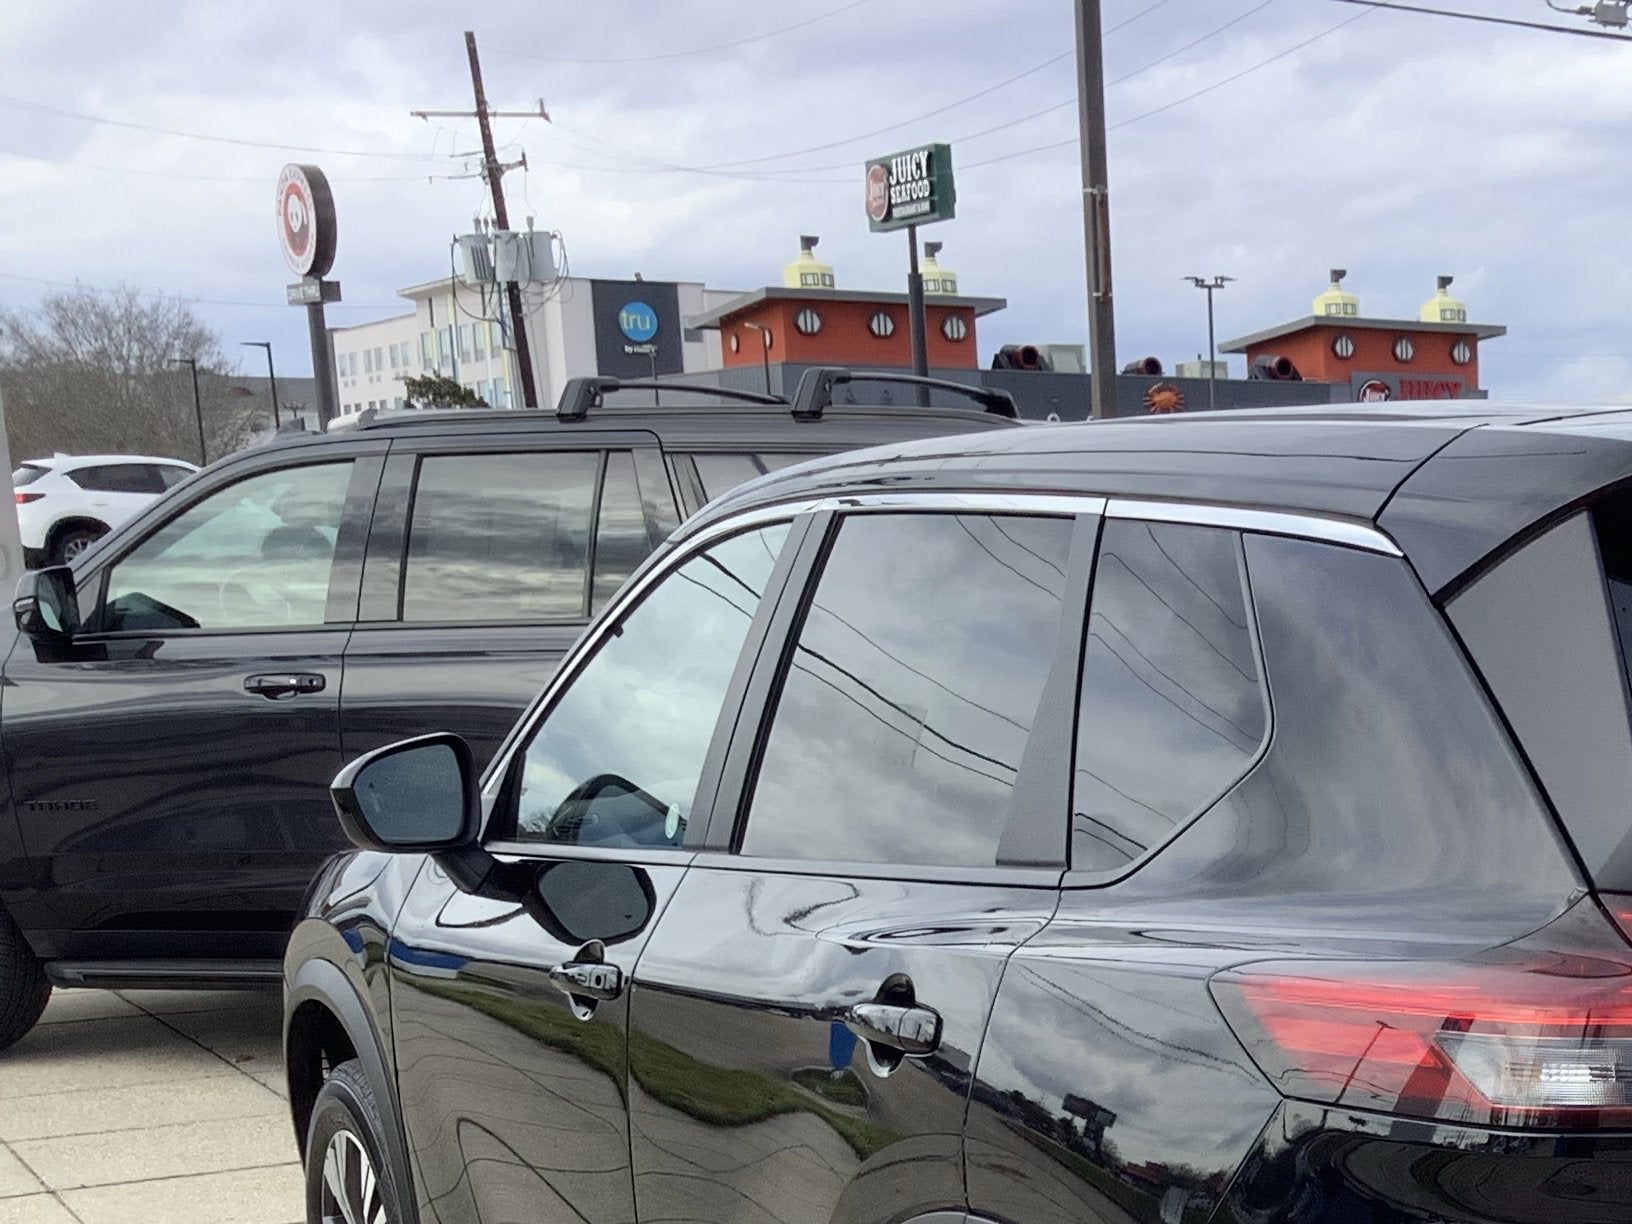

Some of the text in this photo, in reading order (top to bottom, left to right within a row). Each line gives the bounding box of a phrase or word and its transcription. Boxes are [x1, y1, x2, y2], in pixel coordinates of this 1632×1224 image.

[889, 150, 928, 185] JUICY
[890, 179, 930, 205] SEAFOOD
[622, 308, 650, 330] tru
